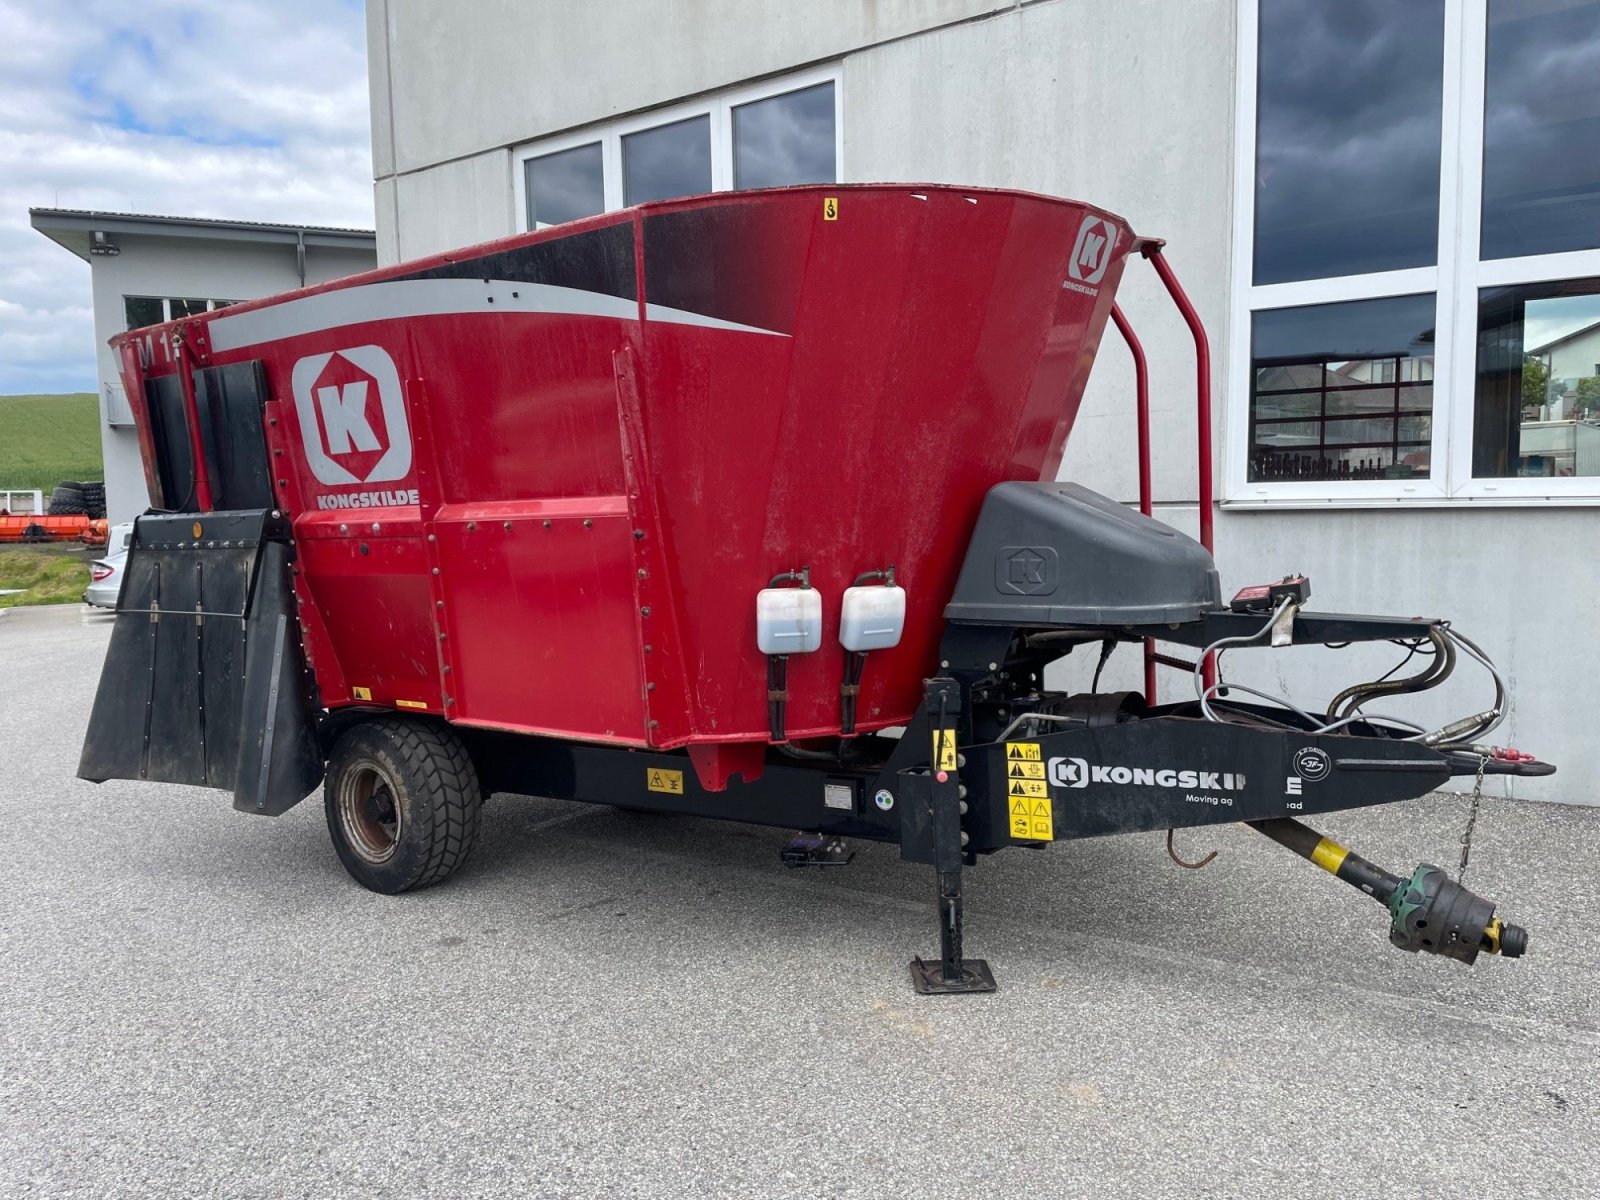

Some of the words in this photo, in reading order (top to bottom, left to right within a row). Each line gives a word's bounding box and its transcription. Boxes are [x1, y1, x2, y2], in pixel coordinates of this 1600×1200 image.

[1079, 232, 1106, 269] K
[317, 380, 382, 455] K
[317, 489, 420, 510] KONGSKILDE
[1057, 763, 1078, 781] K
[1091, 765, 1303, 795] KONGSKIE
[1185, 794, 1219, 806] Moving
